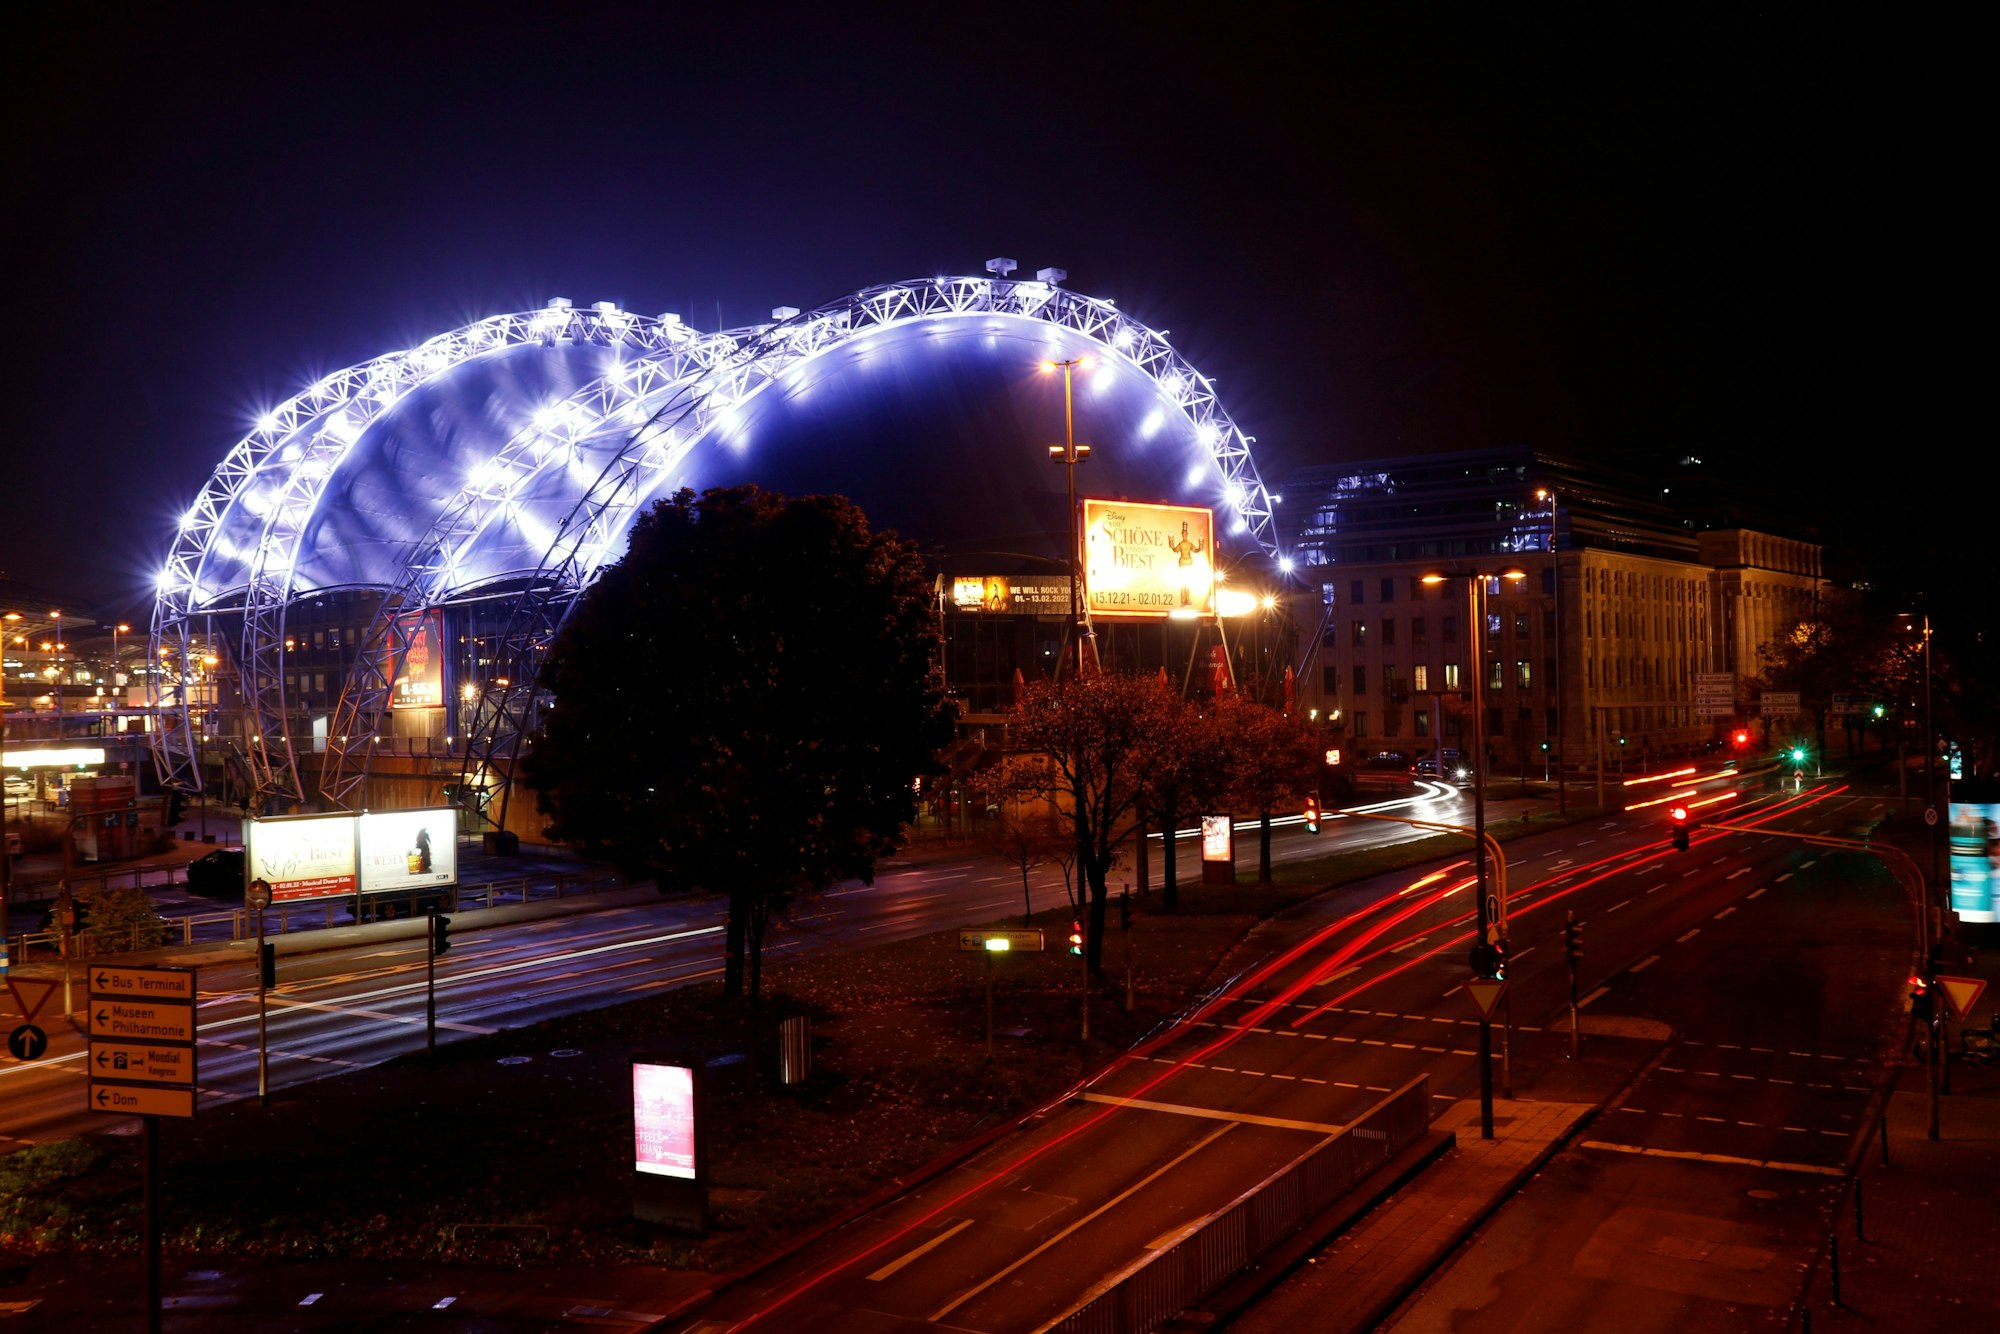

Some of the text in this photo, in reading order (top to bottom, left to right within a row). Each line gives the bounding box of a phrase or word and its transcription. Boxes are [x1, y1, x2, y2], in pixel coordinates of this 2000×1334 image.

[1105, 510, 1126, 521] Disney
[1102, 522, 1163, 546] SCHÖNE
[1113, 546, 1155, 569] BIEST
[1010, 586, 1021, 594] WE
[1023, 586, 1039, 594] WILL
[1041, 586, 1059, 594] ROCK
[1095, 592, 1130, 605] 15.12.21
[1139, 592, 1174, 606] 02.01.22
[302, 879, 323, 887] Musical
[112, 976, 185, 991] Bus Terminal
[112, 1005, 154, 1019] Museen
[112, 1021, 185, 1037] Philharmonie
[148, 1050, 181, 1064] Mondial
[148, 1066, 177, 1077] Kongress
[113, 1092, 138, 1106] Dom
